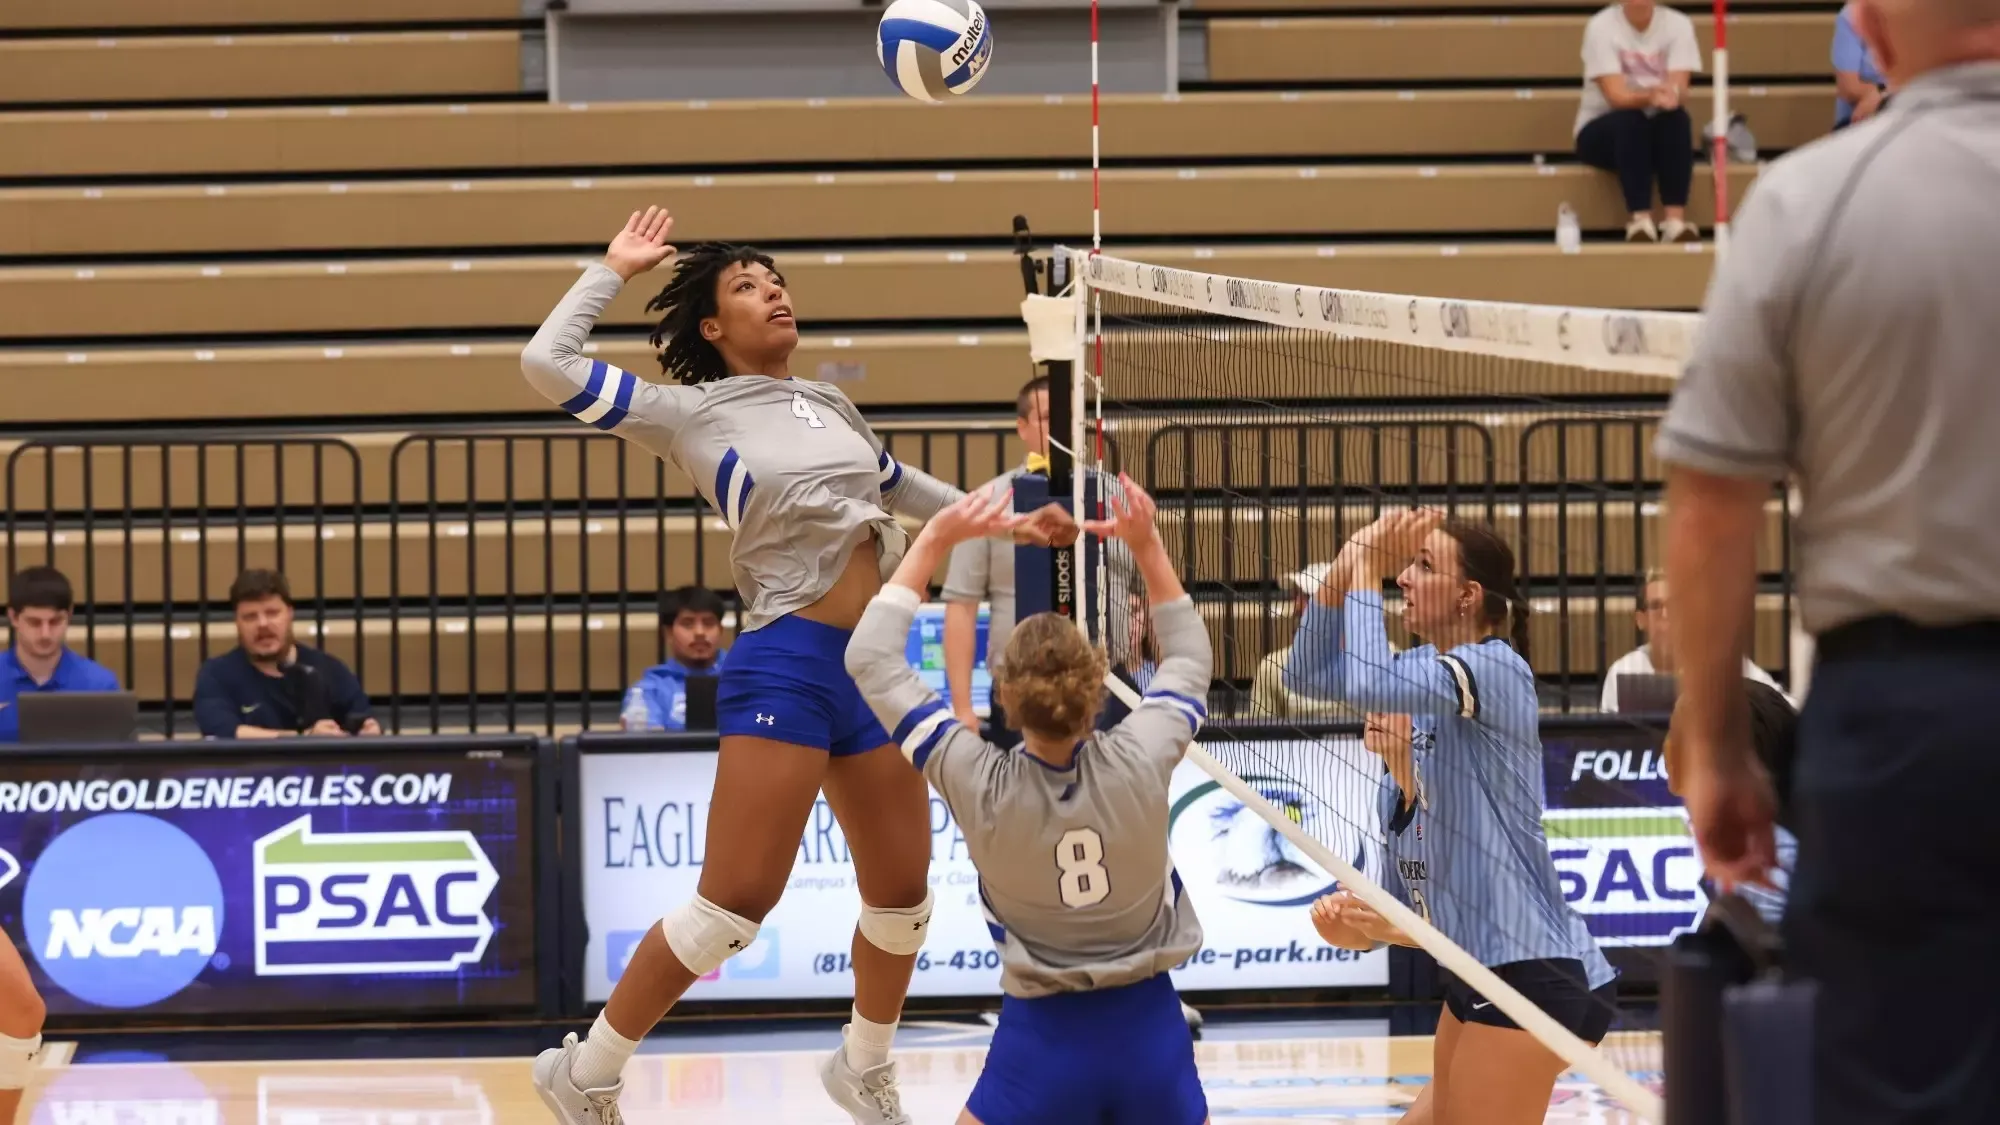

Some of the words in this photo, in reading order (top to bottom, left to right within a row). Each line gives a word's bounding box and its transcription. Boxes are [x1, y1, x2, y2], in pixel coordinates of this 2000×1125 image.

[952, 11, 984, 67] molten
[791, 390, 826, 428] 4
[0, 772, 453, 813] RIONGOLDENEAGLES.COM
[602, 796, 707, 869] EAGL
[946, 870, 979, 885] Clar
[1055, 826, 1112, 909] 8
[264, 871, 478, 930] PSAC
[45, 905, 217, 960] NCAA
[813, 952, 852, 975] (81
[917, 950, 1000, 971] 6-430
